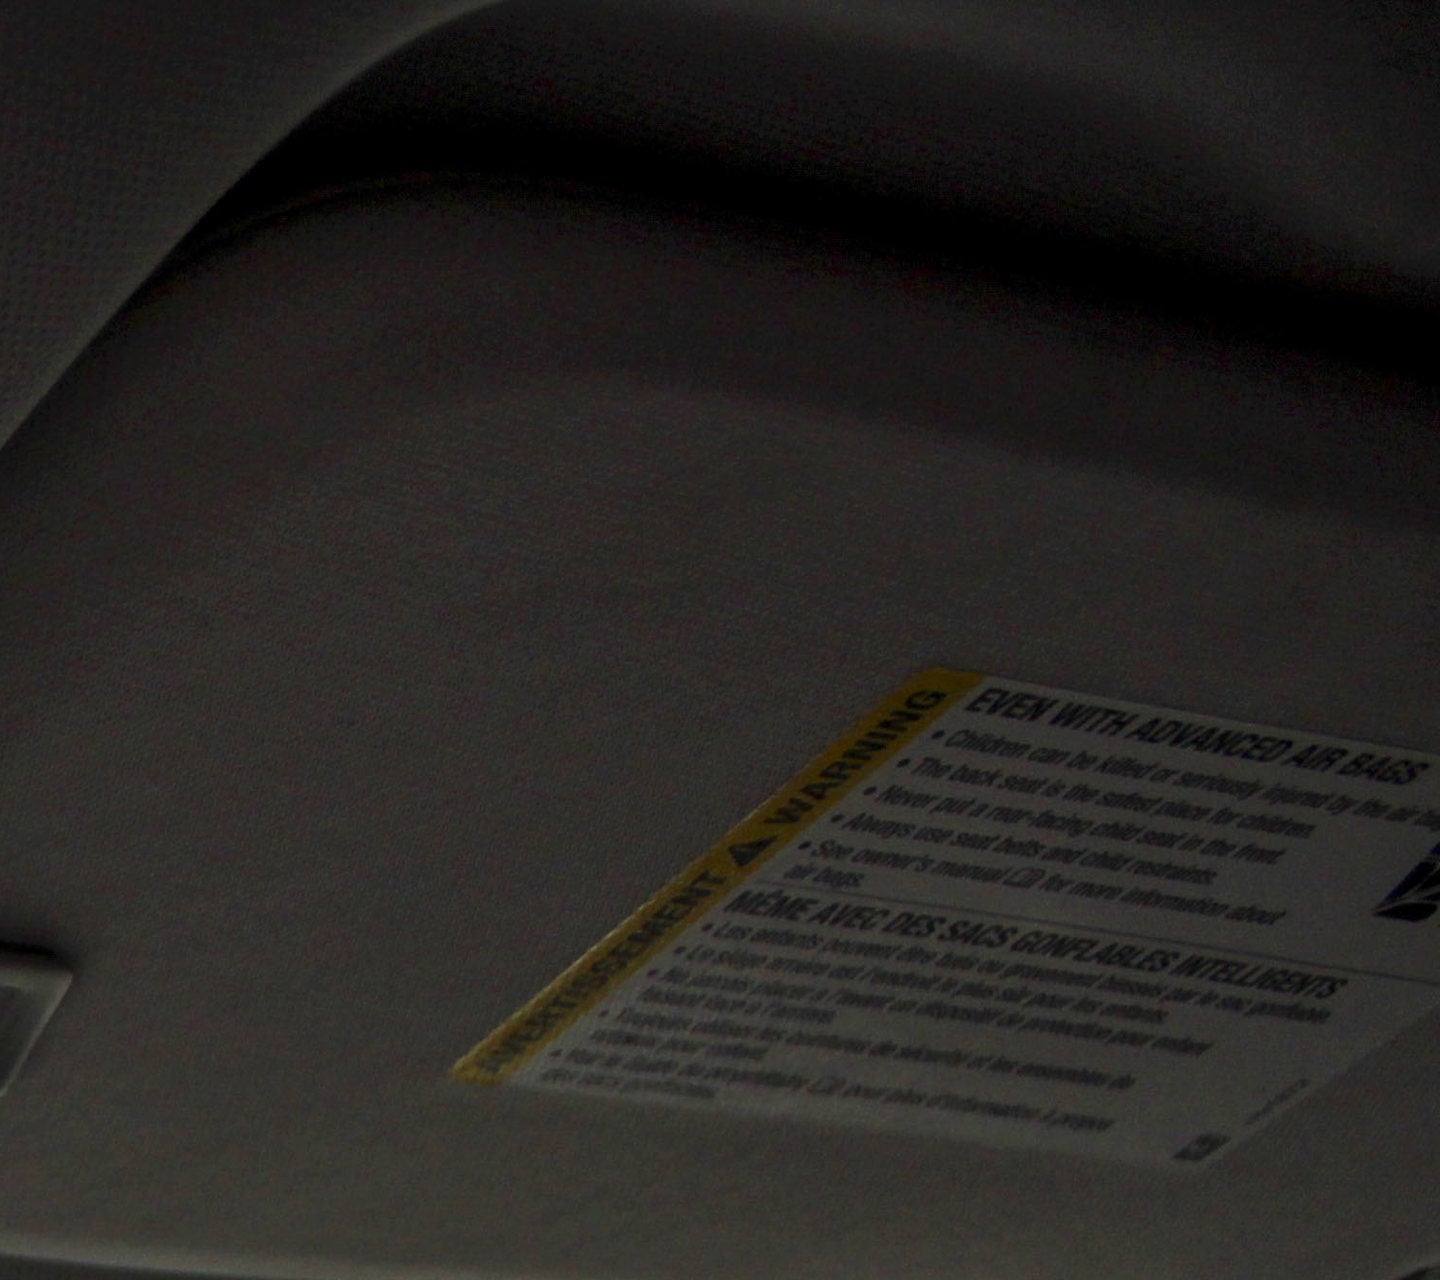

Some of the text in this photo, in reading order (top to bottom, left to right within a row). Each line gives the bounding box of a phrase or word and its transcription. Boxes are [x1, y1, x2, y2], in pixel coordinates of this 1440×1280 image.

[763, 690, 947, 824] WARNING
[911, 756, 952, 779] The
[945, 729, 1032, 757] Children
[1027, 747, 1070, 765] can
[964, 688, 1430, 785] EVEN WITH ADVANCED AIR BAGS
[875, 785, 940, 809] Never
[810, 902, 890, 932] AVEC
[882, 911, 946, 939] DES
[938, 919, 1018, 949] SACS
[1010, 930, 1179, 974] GONFLABLES
[1169, 954, 1348, 999] INTELLIGENTS
